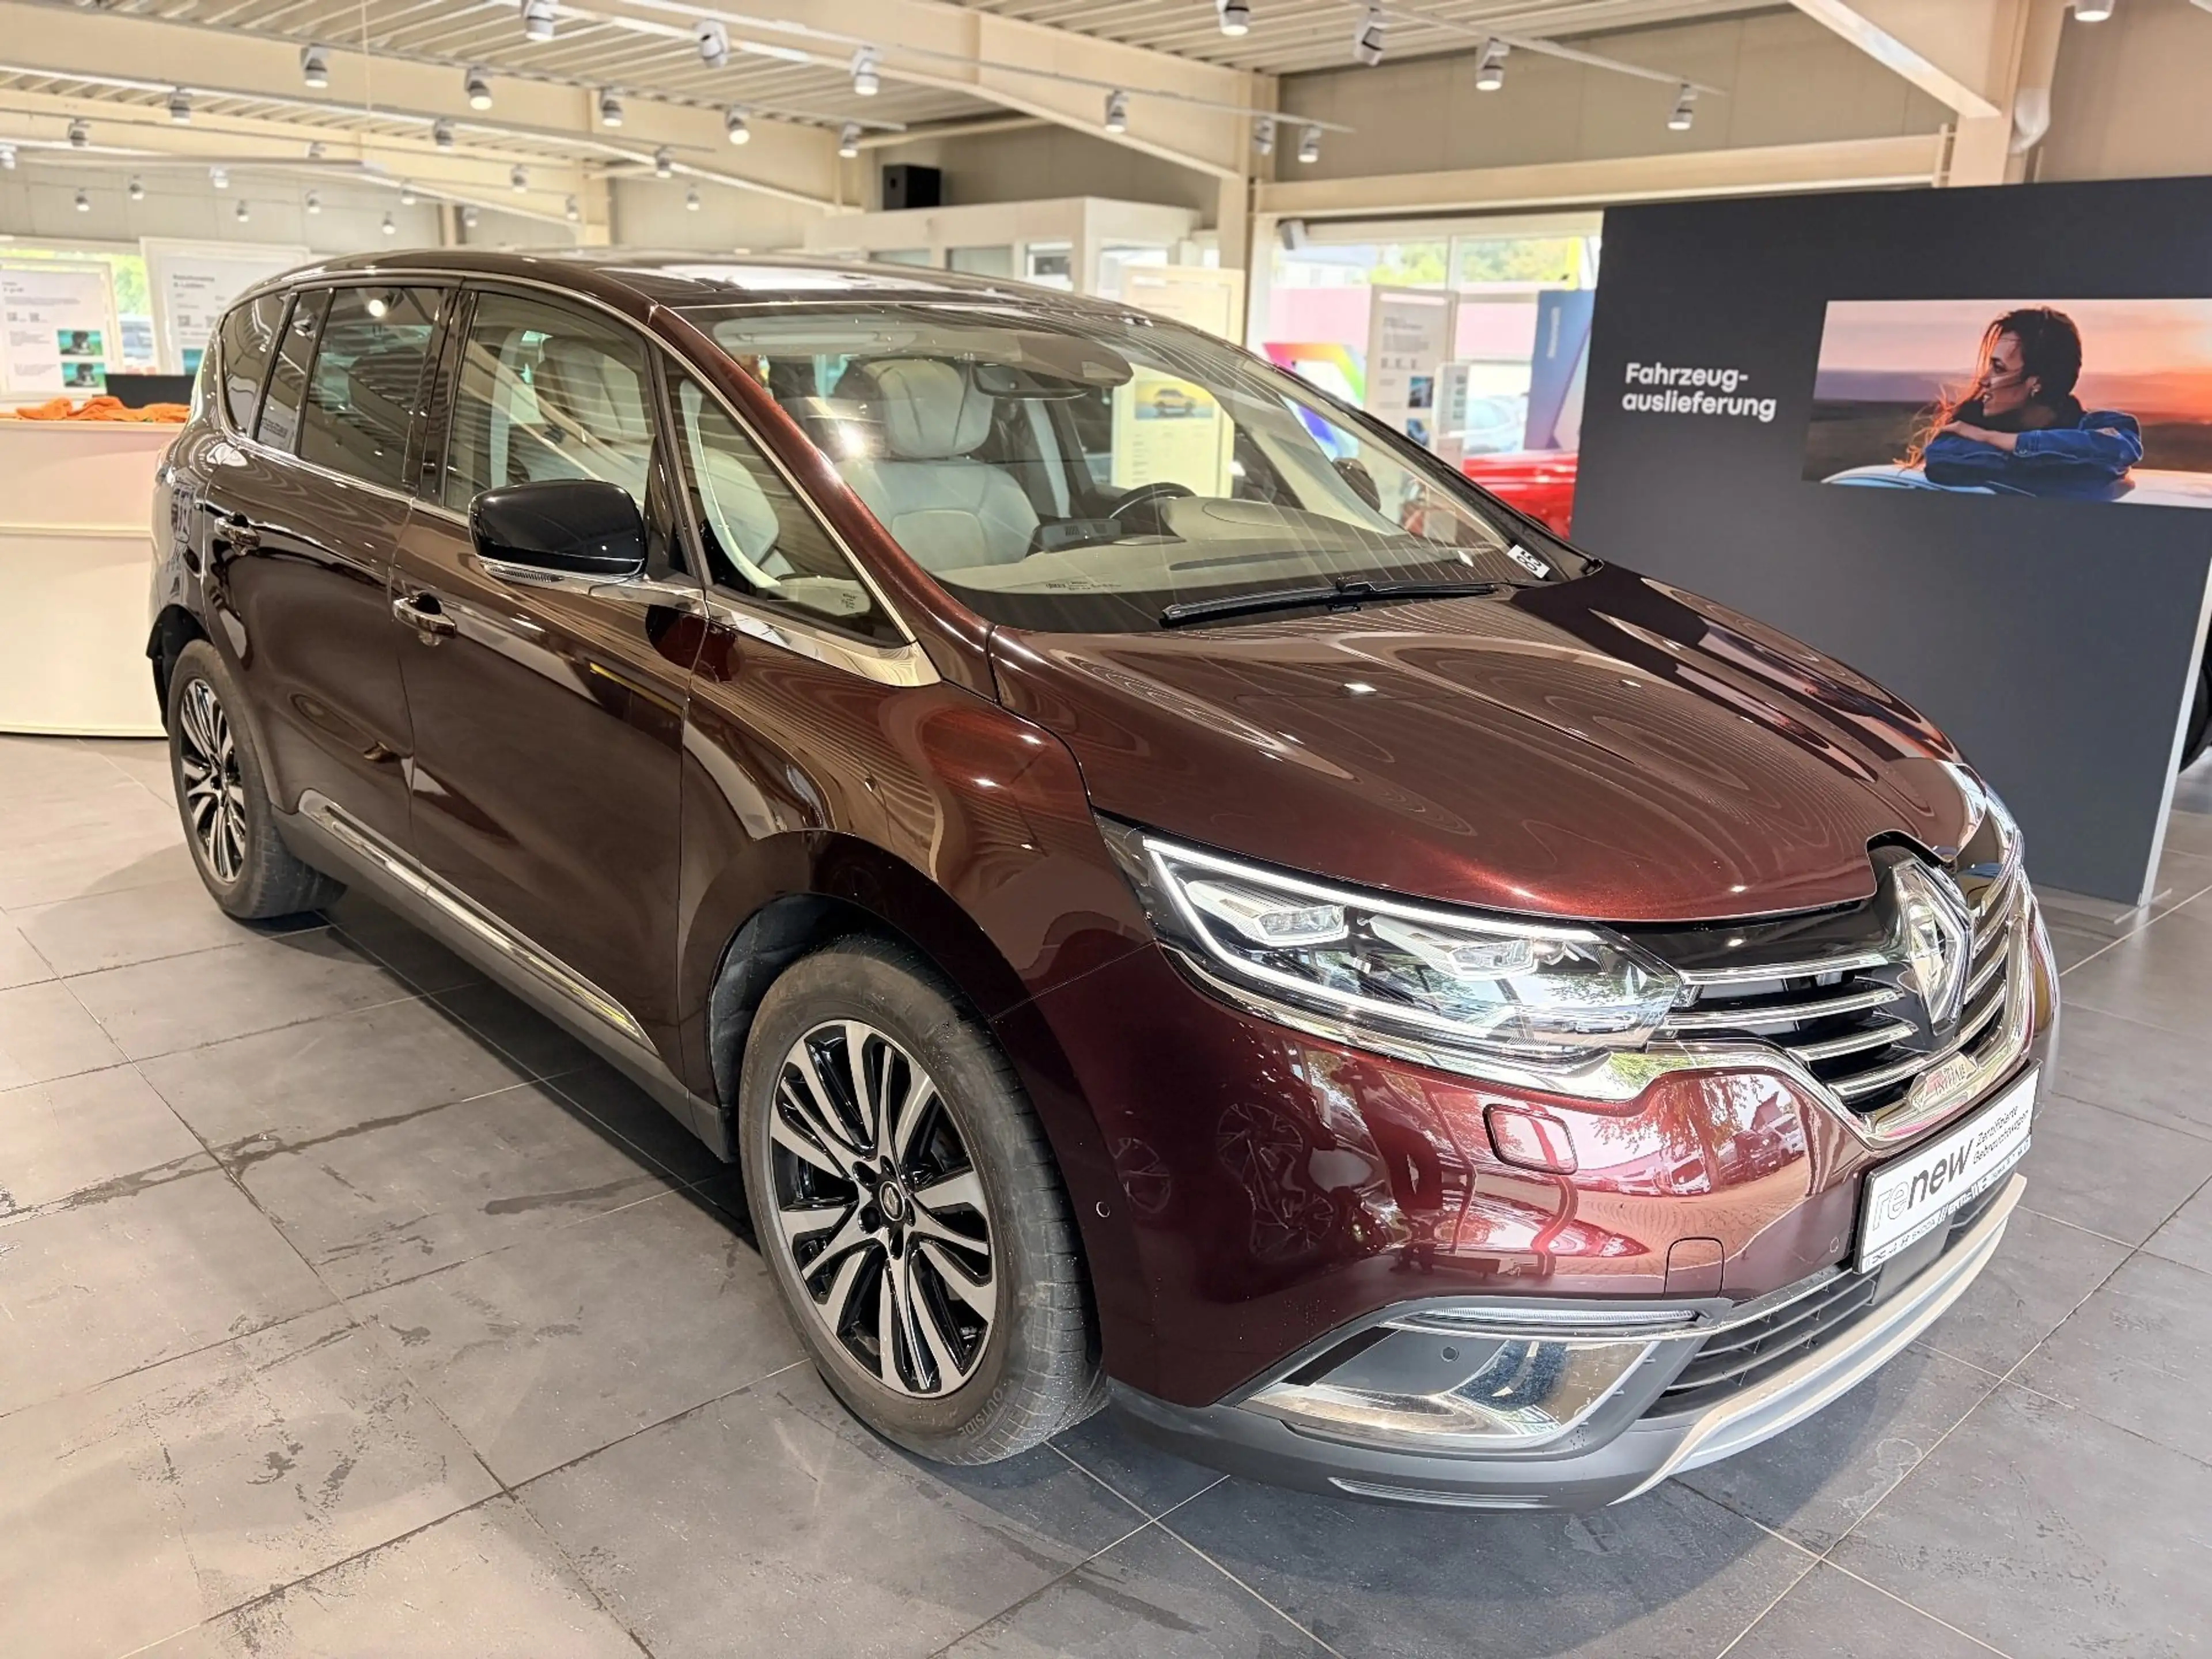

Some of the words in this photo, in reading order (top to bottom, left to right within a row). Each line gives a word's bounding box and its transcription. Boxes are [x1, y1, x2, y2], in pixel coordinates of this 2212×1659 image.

[1625, 362, 1749, 393] Fahrzeug-
[1622, 390, 1777, 422] auslieferung
[1872, 1138, 1974, 1232] renew
[959, 1388, 1002, 1437] OUTSIDE
